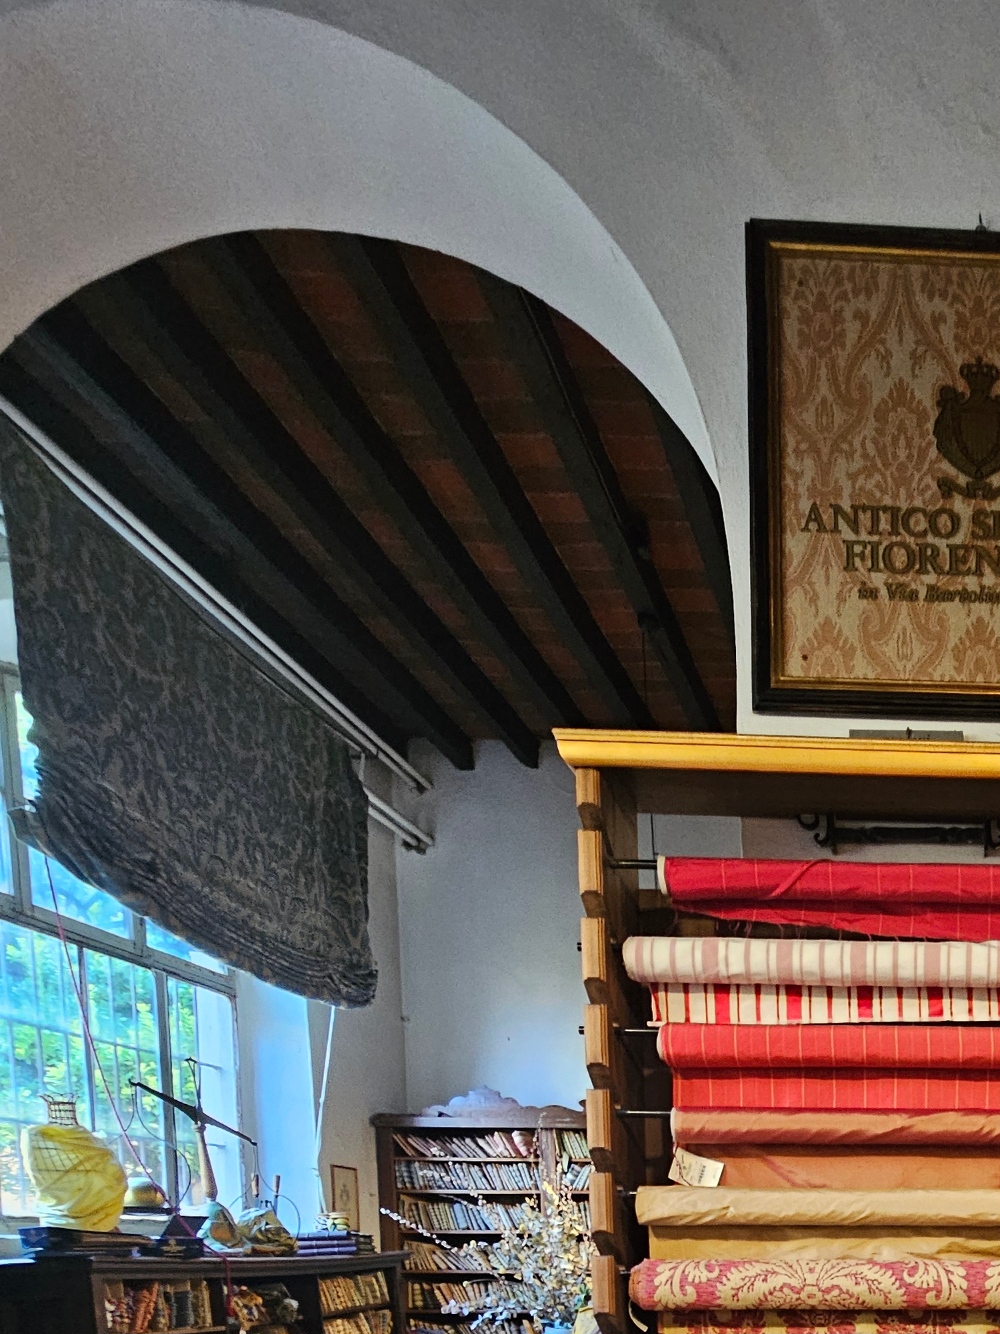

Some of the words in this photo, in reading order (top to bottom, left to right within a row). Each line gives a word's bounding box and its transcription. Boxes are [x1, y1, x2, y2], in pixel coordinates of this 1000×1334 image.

[801, 501, 961, 540] ANTICO
[857, 582, 879, 600] in
[884, 581, 919, 601] Via
